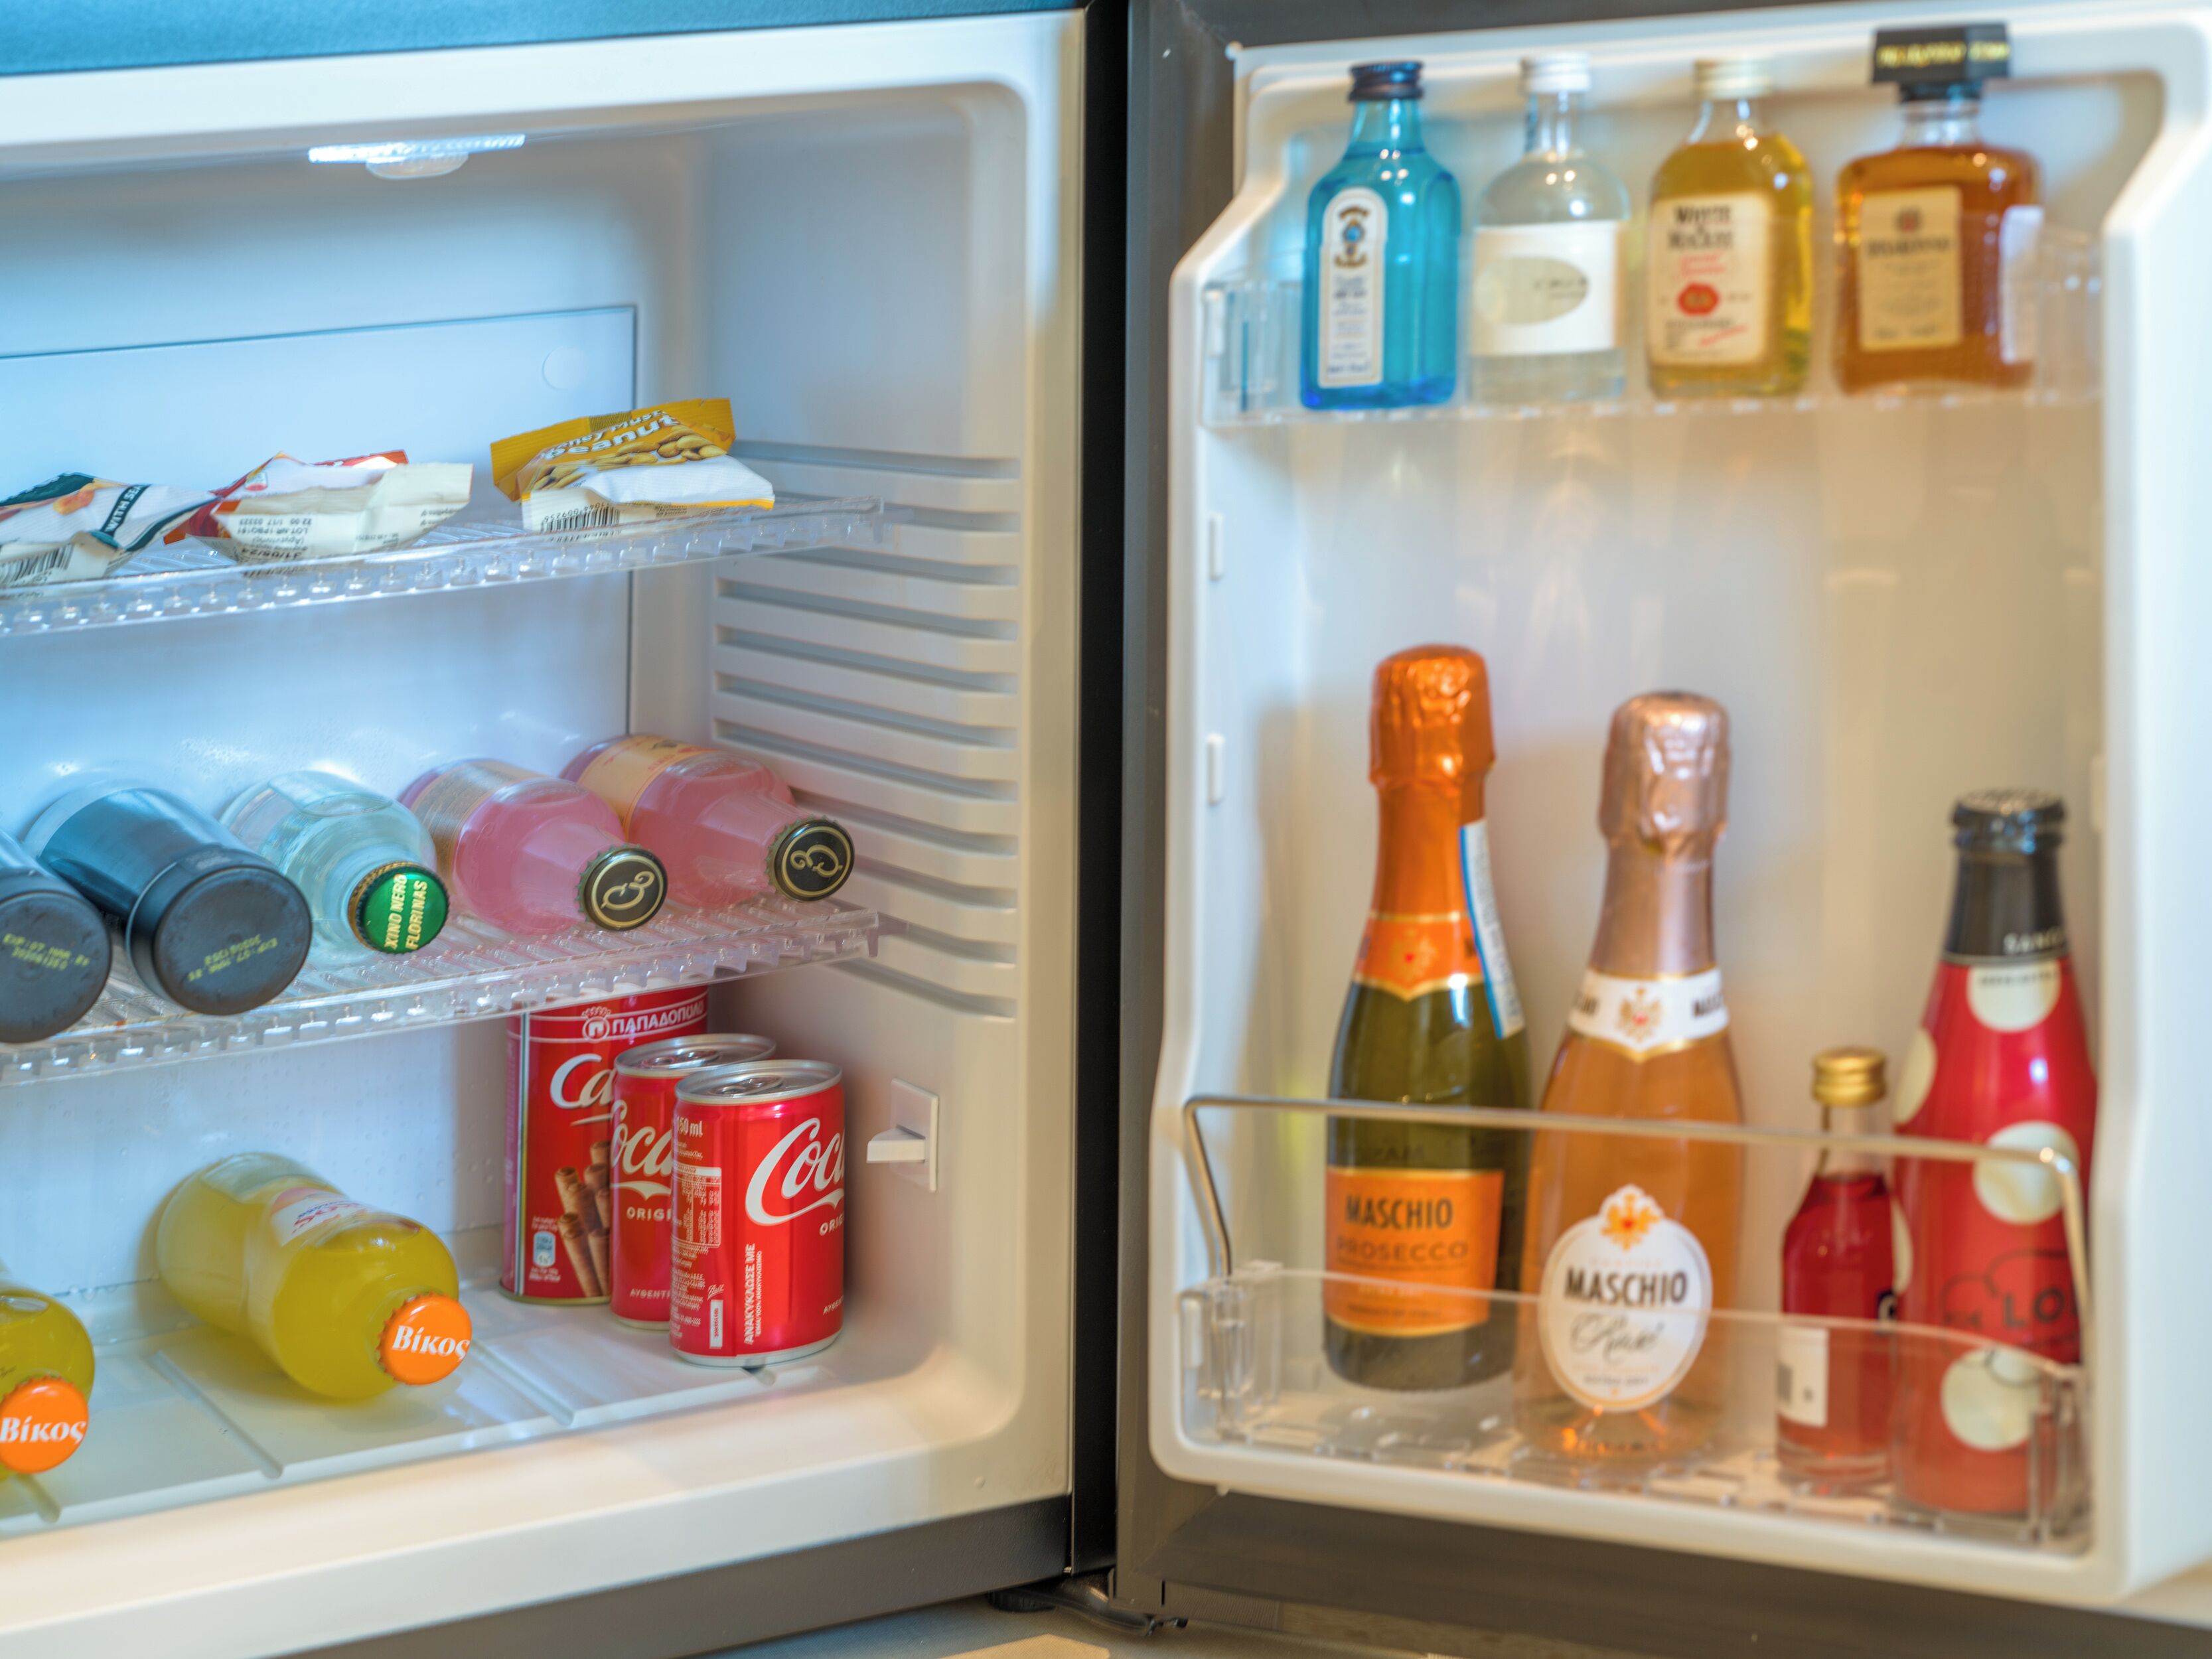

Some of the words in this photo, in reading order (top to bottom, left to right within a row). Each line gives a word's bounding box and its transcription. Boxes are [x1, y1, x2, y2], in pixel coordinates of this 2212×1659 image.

[104, 500, 130, 532] WITH
[390, 874, 407, 912] NERO
[384, 913, 402, 950] XINO
[405, 880, 427, 950] FLORINAS
[1345, 1193, 1453, 1230] MASCHIO
[1337, 1237, 1469, 1262] PROSECCO
[1565, 1267, 1688, 1307] MASCHIO
[392, 1325, 471, 1364] Βίκος
[0, 1413, 86, 1445] Βίκος
